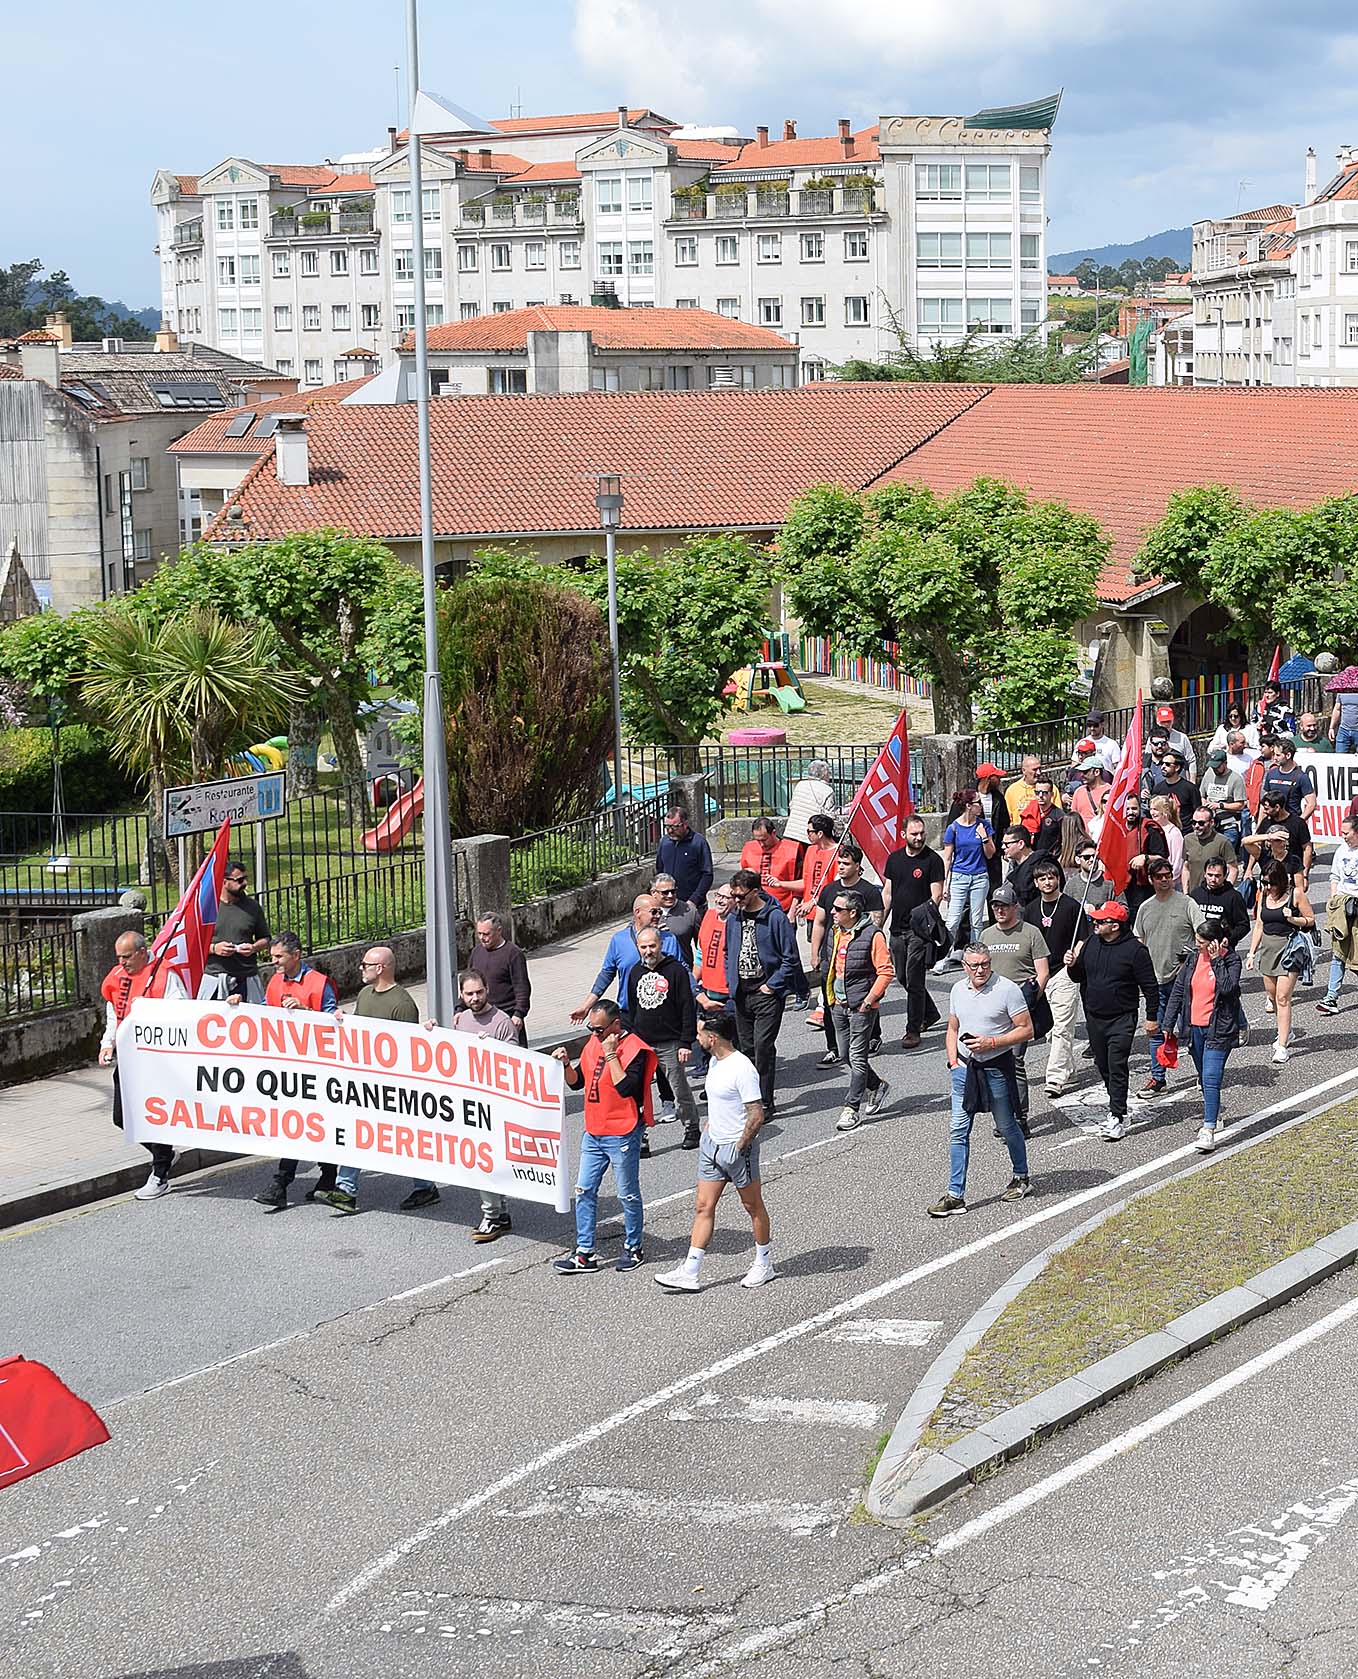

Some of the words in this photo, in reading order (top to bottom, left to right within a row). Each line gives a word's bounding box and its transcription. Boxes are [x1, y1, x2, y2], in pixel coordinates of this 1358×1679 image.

[205, 785, 254, 801] Restaurante
[134, 1024, 163, 1046] POR
[168, 1025, 188, 1047] UN
[197, 1013, 398, 1069] CONVENIO
[411, 1036, 457, 1078] DO
[469, 1047, 560, 1103] METAL
[197, 1066, 245, 1094] NO
[256, 1069, 314, 1102] QUE
[326, 1077, 454, 1123] GANEMOS
[463, 1100, 492, 1131] EN
[145, 1096, 325, 1143] SALARIOS
[335, 1128, 345, 1147] E
[355, 1119, 494, 1174] DEREITOS
